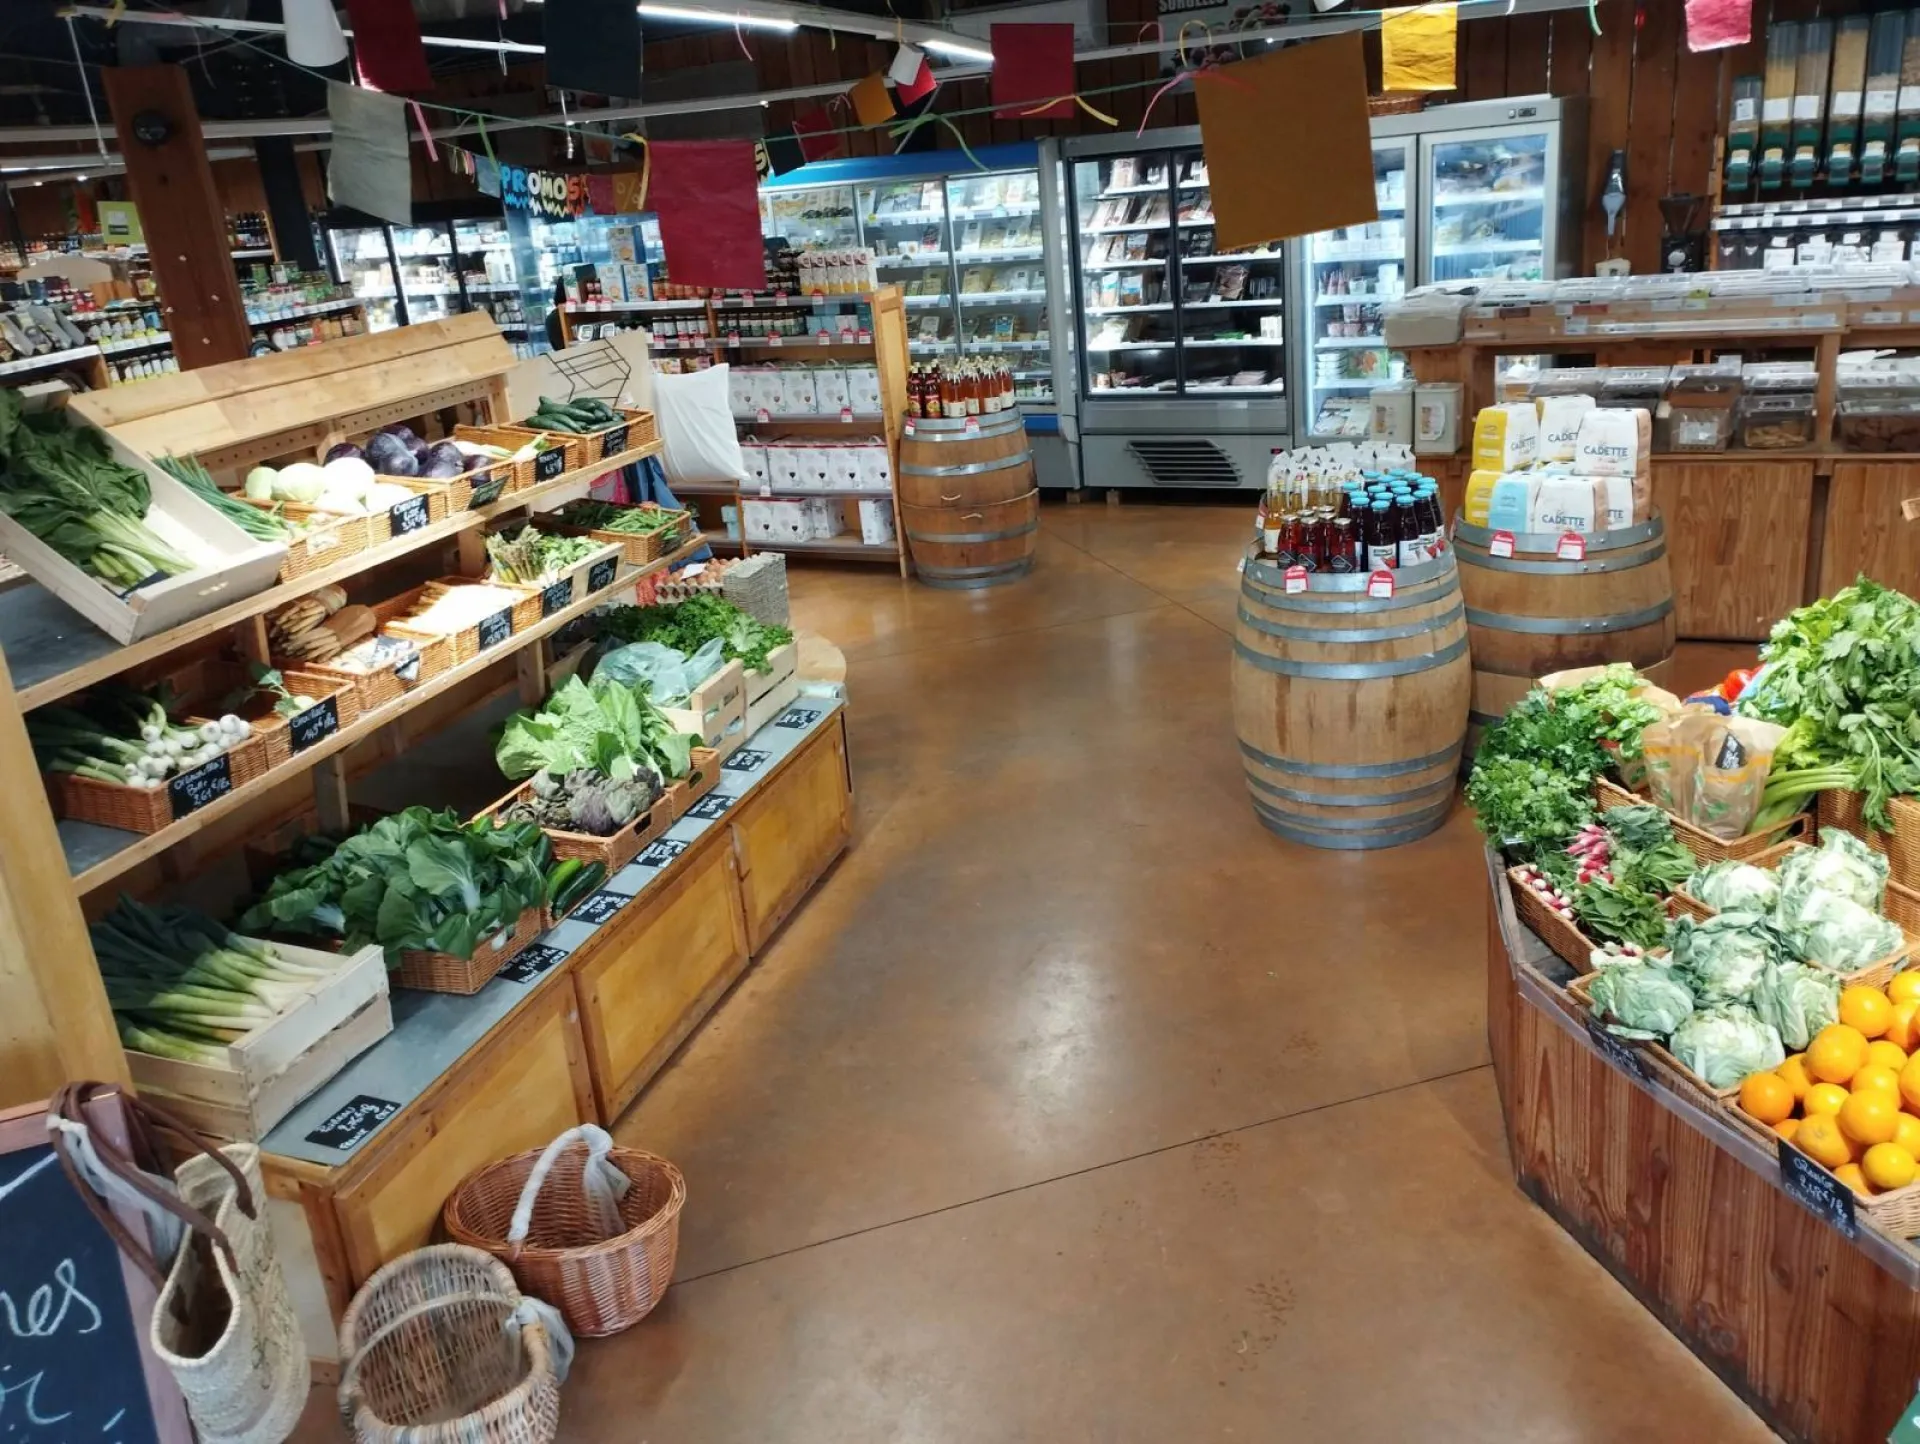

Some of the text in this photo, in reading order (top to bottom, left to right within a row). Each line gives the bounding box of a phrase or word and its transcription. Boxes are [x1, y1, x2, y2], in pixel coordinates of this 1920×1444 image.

[500, 164, 582, 201] PROMOS
[1583, 445, 1629, 458] CADETTE
[1541, 514, 1585, 527] CADETTE
